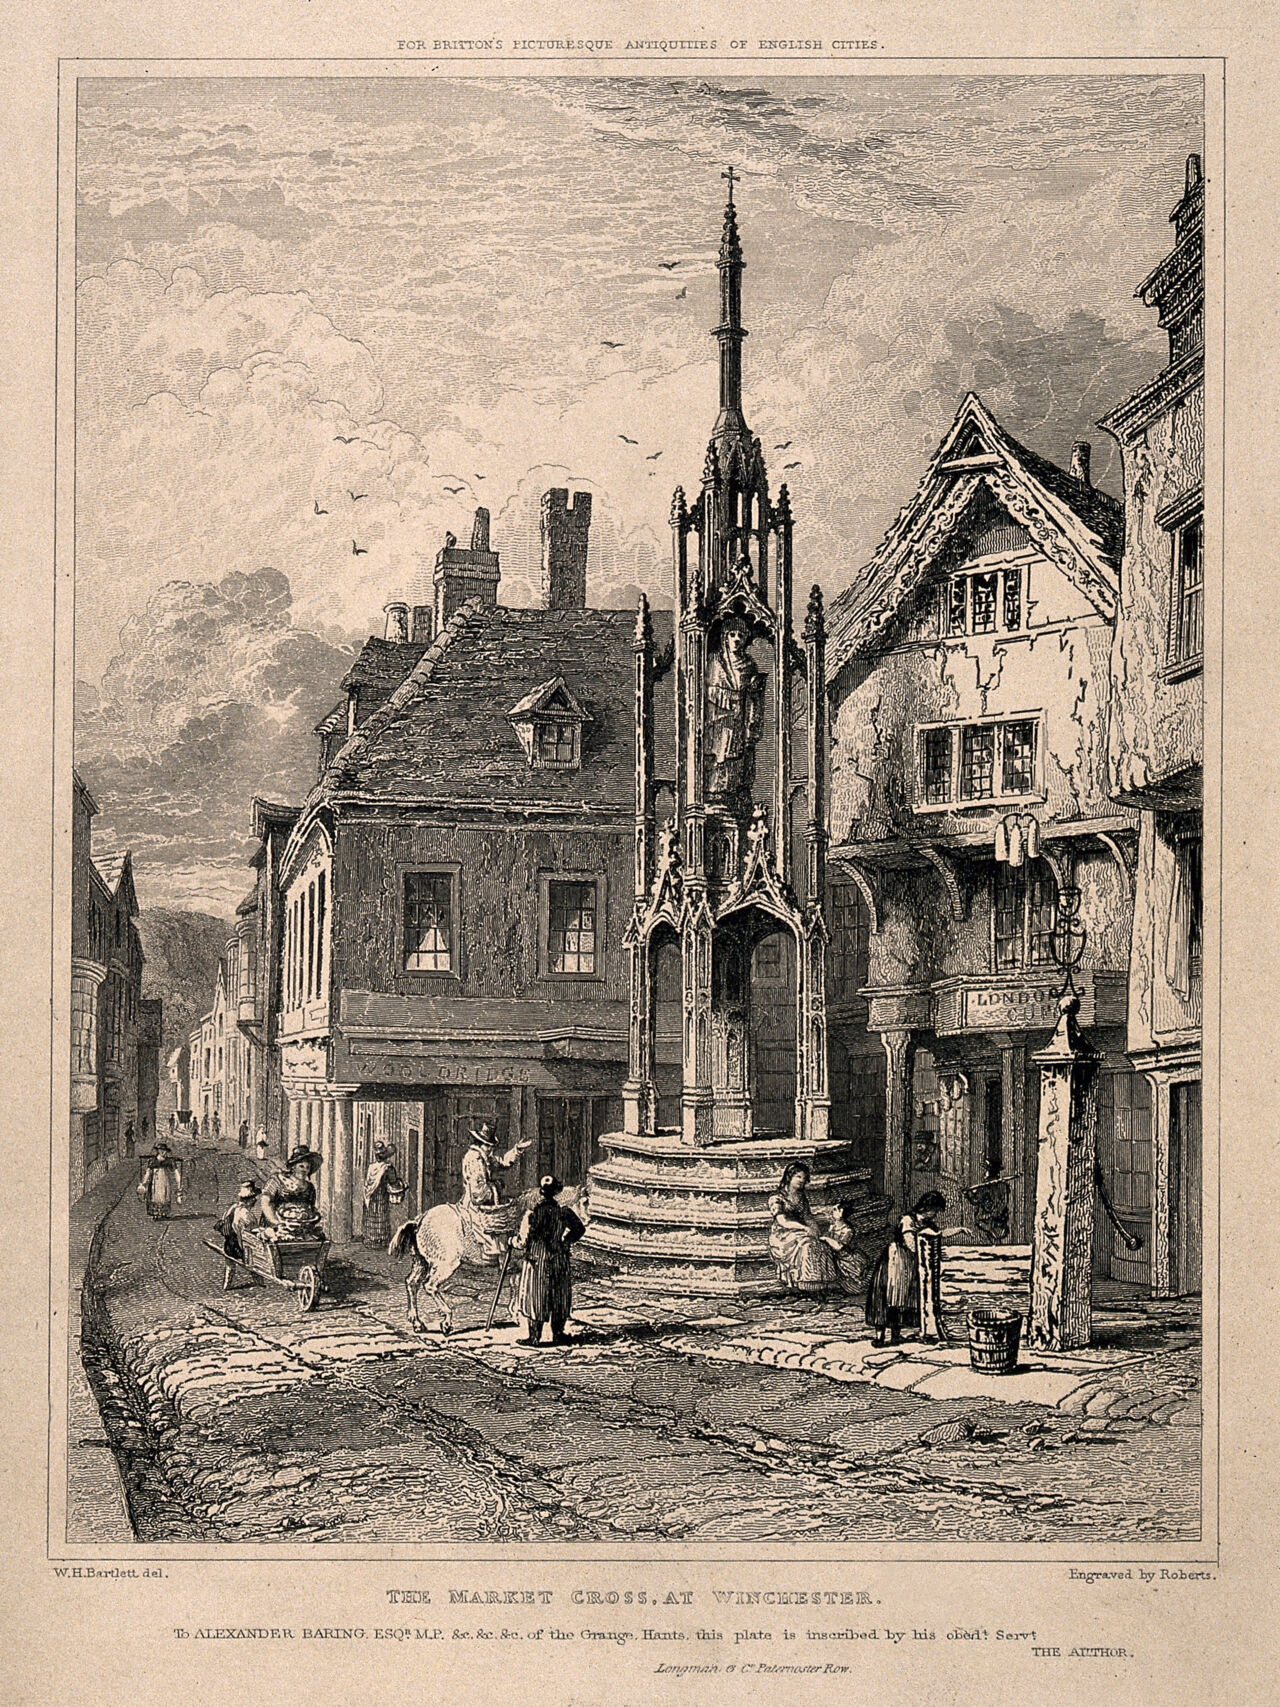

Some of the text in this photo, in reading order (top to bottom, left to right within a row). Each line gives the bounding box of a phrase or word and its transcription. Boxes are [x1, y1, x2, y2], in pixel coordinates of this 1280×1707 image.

[397, 40, 427, 50] FOR
[513, 40, 613, 52] PICTURESQUE
[624, 40, 717, 52] ANTIQUITIES
[729, 40, 748, 50] OF
[758, 40, 824, 50] ENGLISH
[143, 1568, 168, 1579] del.
[1069, 1568, 1219, 1584] Engraved by Roberts.
[386, 1589, 432, 1605] THE
[448, 1589, 554, 1605] MARKET
[661, 1590, 694, 1605] AT
[712, 1590, 882, 1606] WINCHESTER.
[173, 1627, 190, 1640] To
[193, 1628, 295, 1640] ALEXANDER
[527, 1628, 545, 1641] of
[548, 1627, 574, 1641] the
[695, 1628, 723, 1641] this
[734, 1629, 772, 1645] plate
[781, 1628, 796, 1641] is
[805, 1628, 881, 1641] inscribed
[884, 1629, 906, 1645] by
[911, 1628, 937, 1641] his
[1031, 1647, 1062, 1658] THE
[755, 1662, 823, 1674] Paternoster
